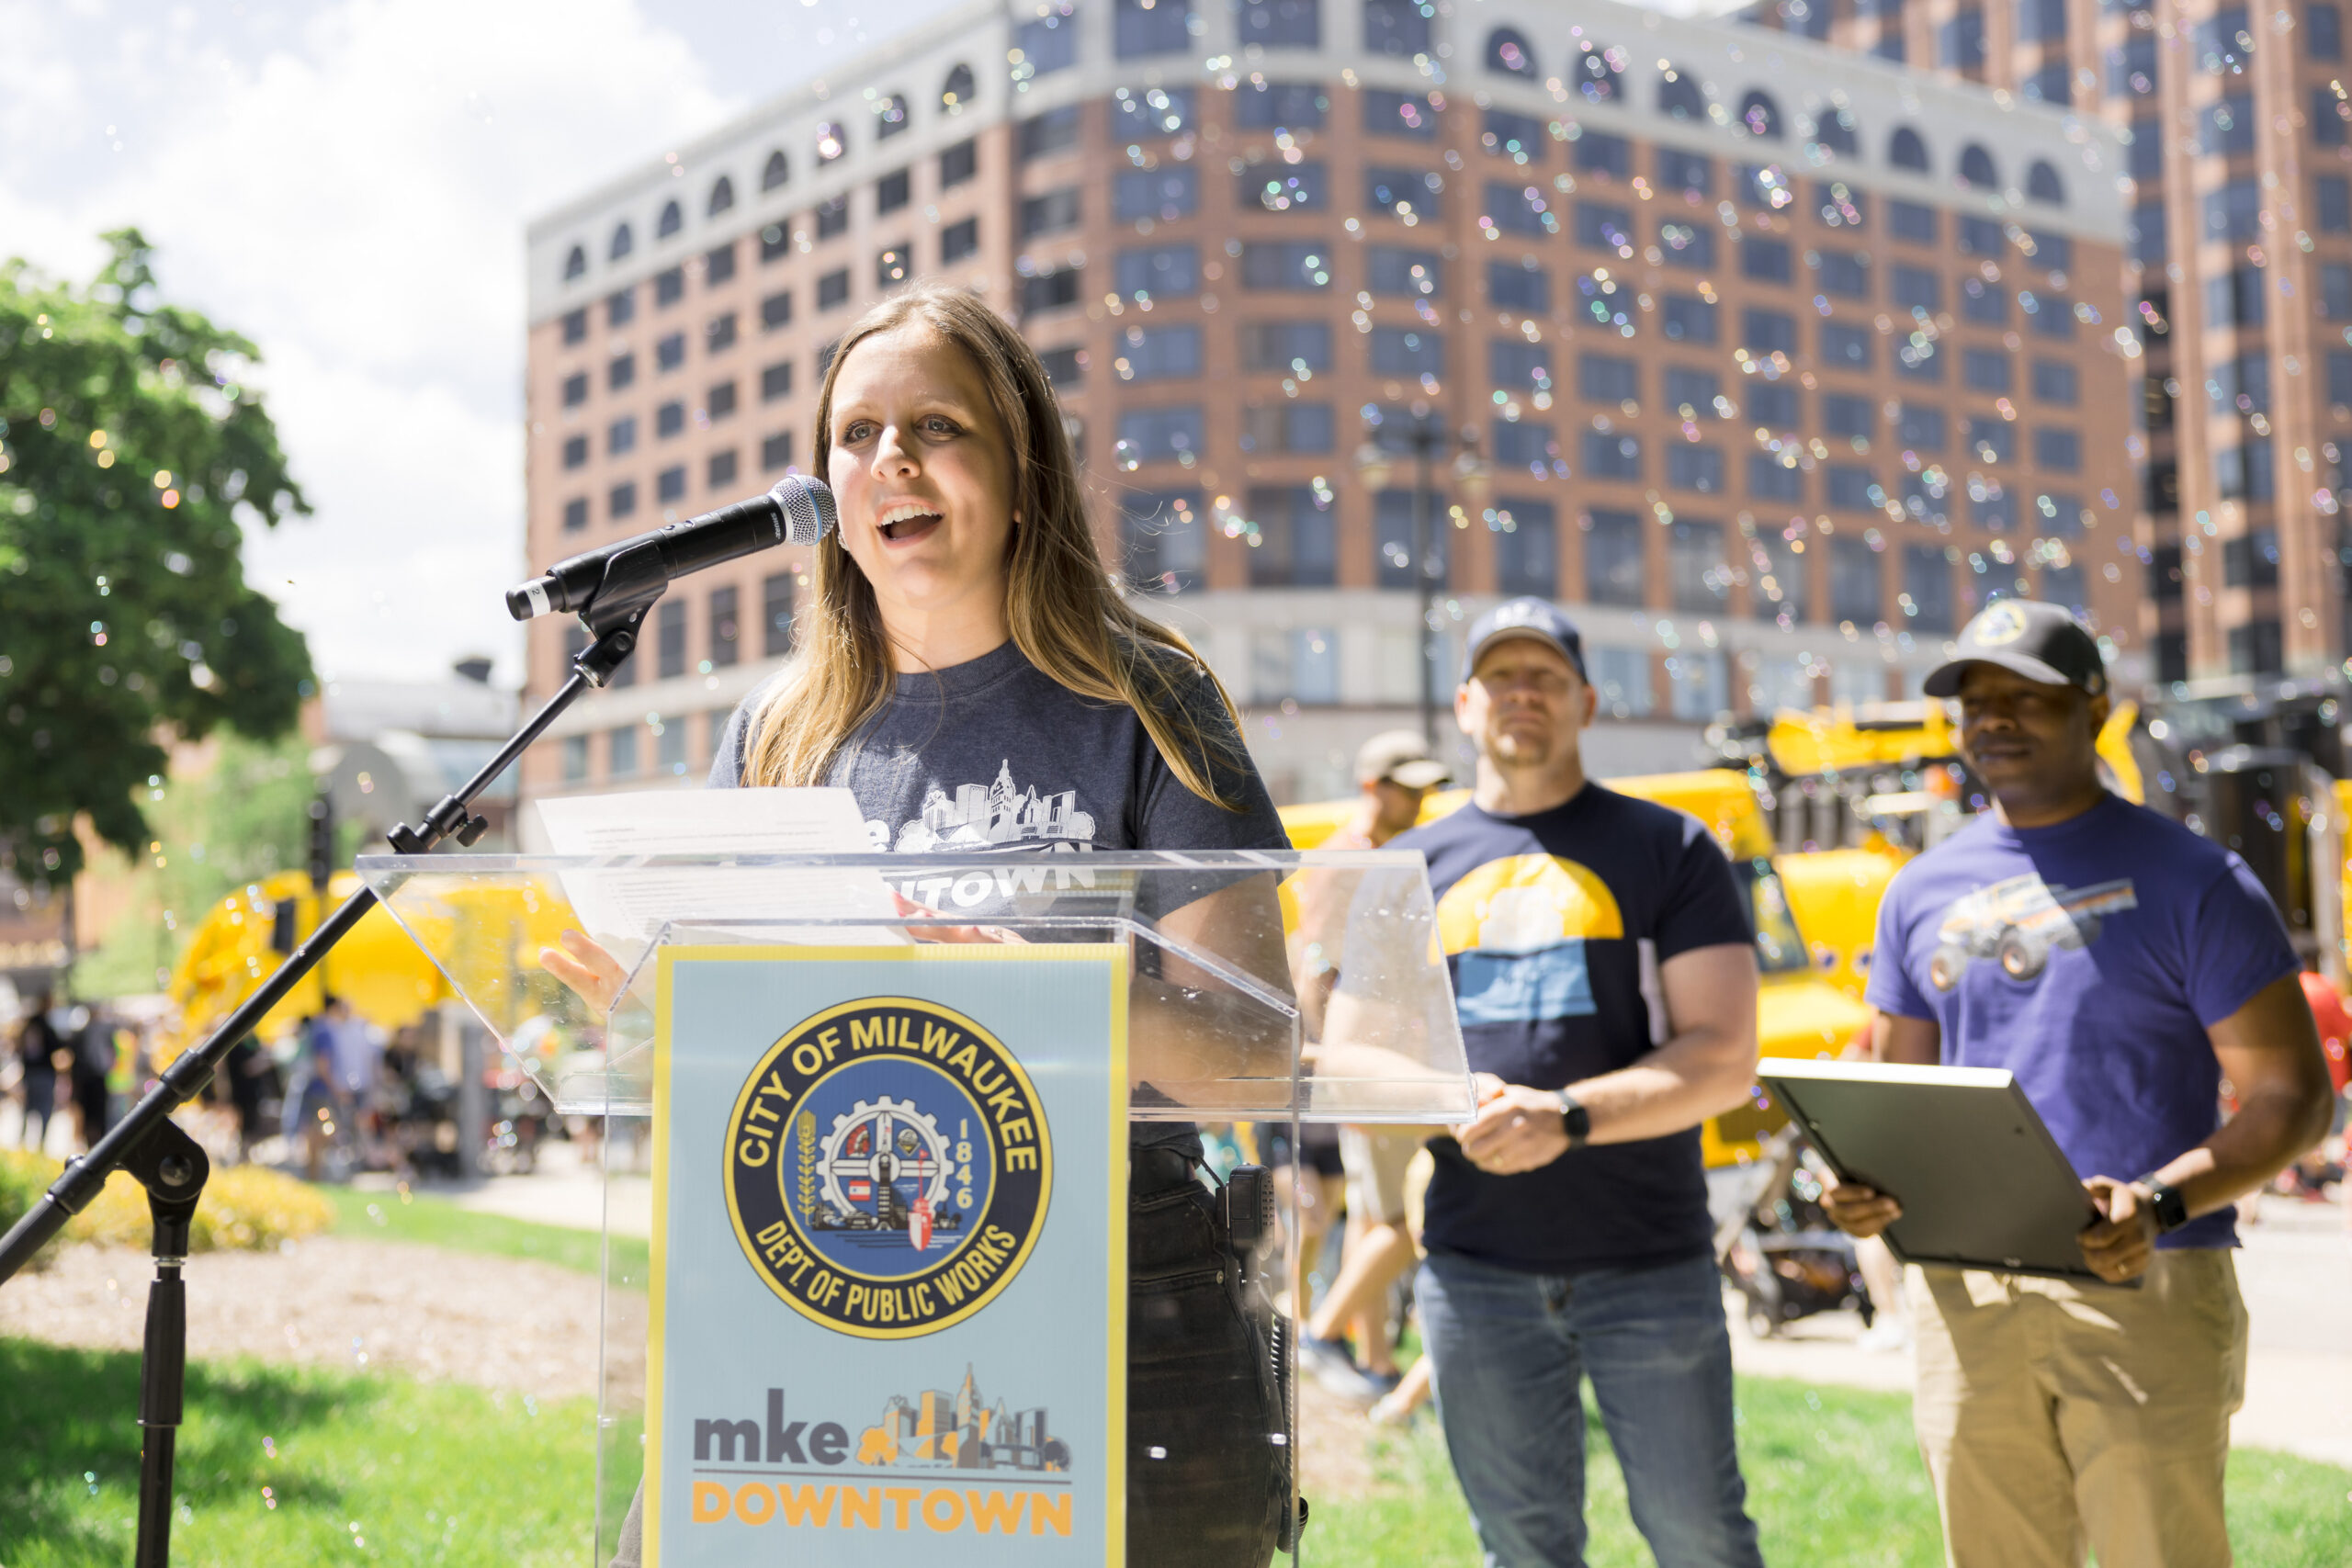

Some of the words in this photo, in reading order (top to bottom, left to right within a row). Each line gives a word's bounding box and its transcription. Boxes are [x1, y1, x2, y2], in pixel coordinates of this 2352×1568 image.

[739, 1070, 792, 1168] CITY
[791, 1026, 842, 1076] OF
[849, 1016, 1037, 1173] MILWAUKEE
[956, 1118, 973, 1209] 1846
[807, 1269, 845, 1307] OF
[843, 1282, 935, 1322] PUBLIC
[933, 1224, 1016, 1306] WORKS
[694, 1388, 849, 1466] mke
[692, 1481, 1072, 1537] DOWNTOWN
